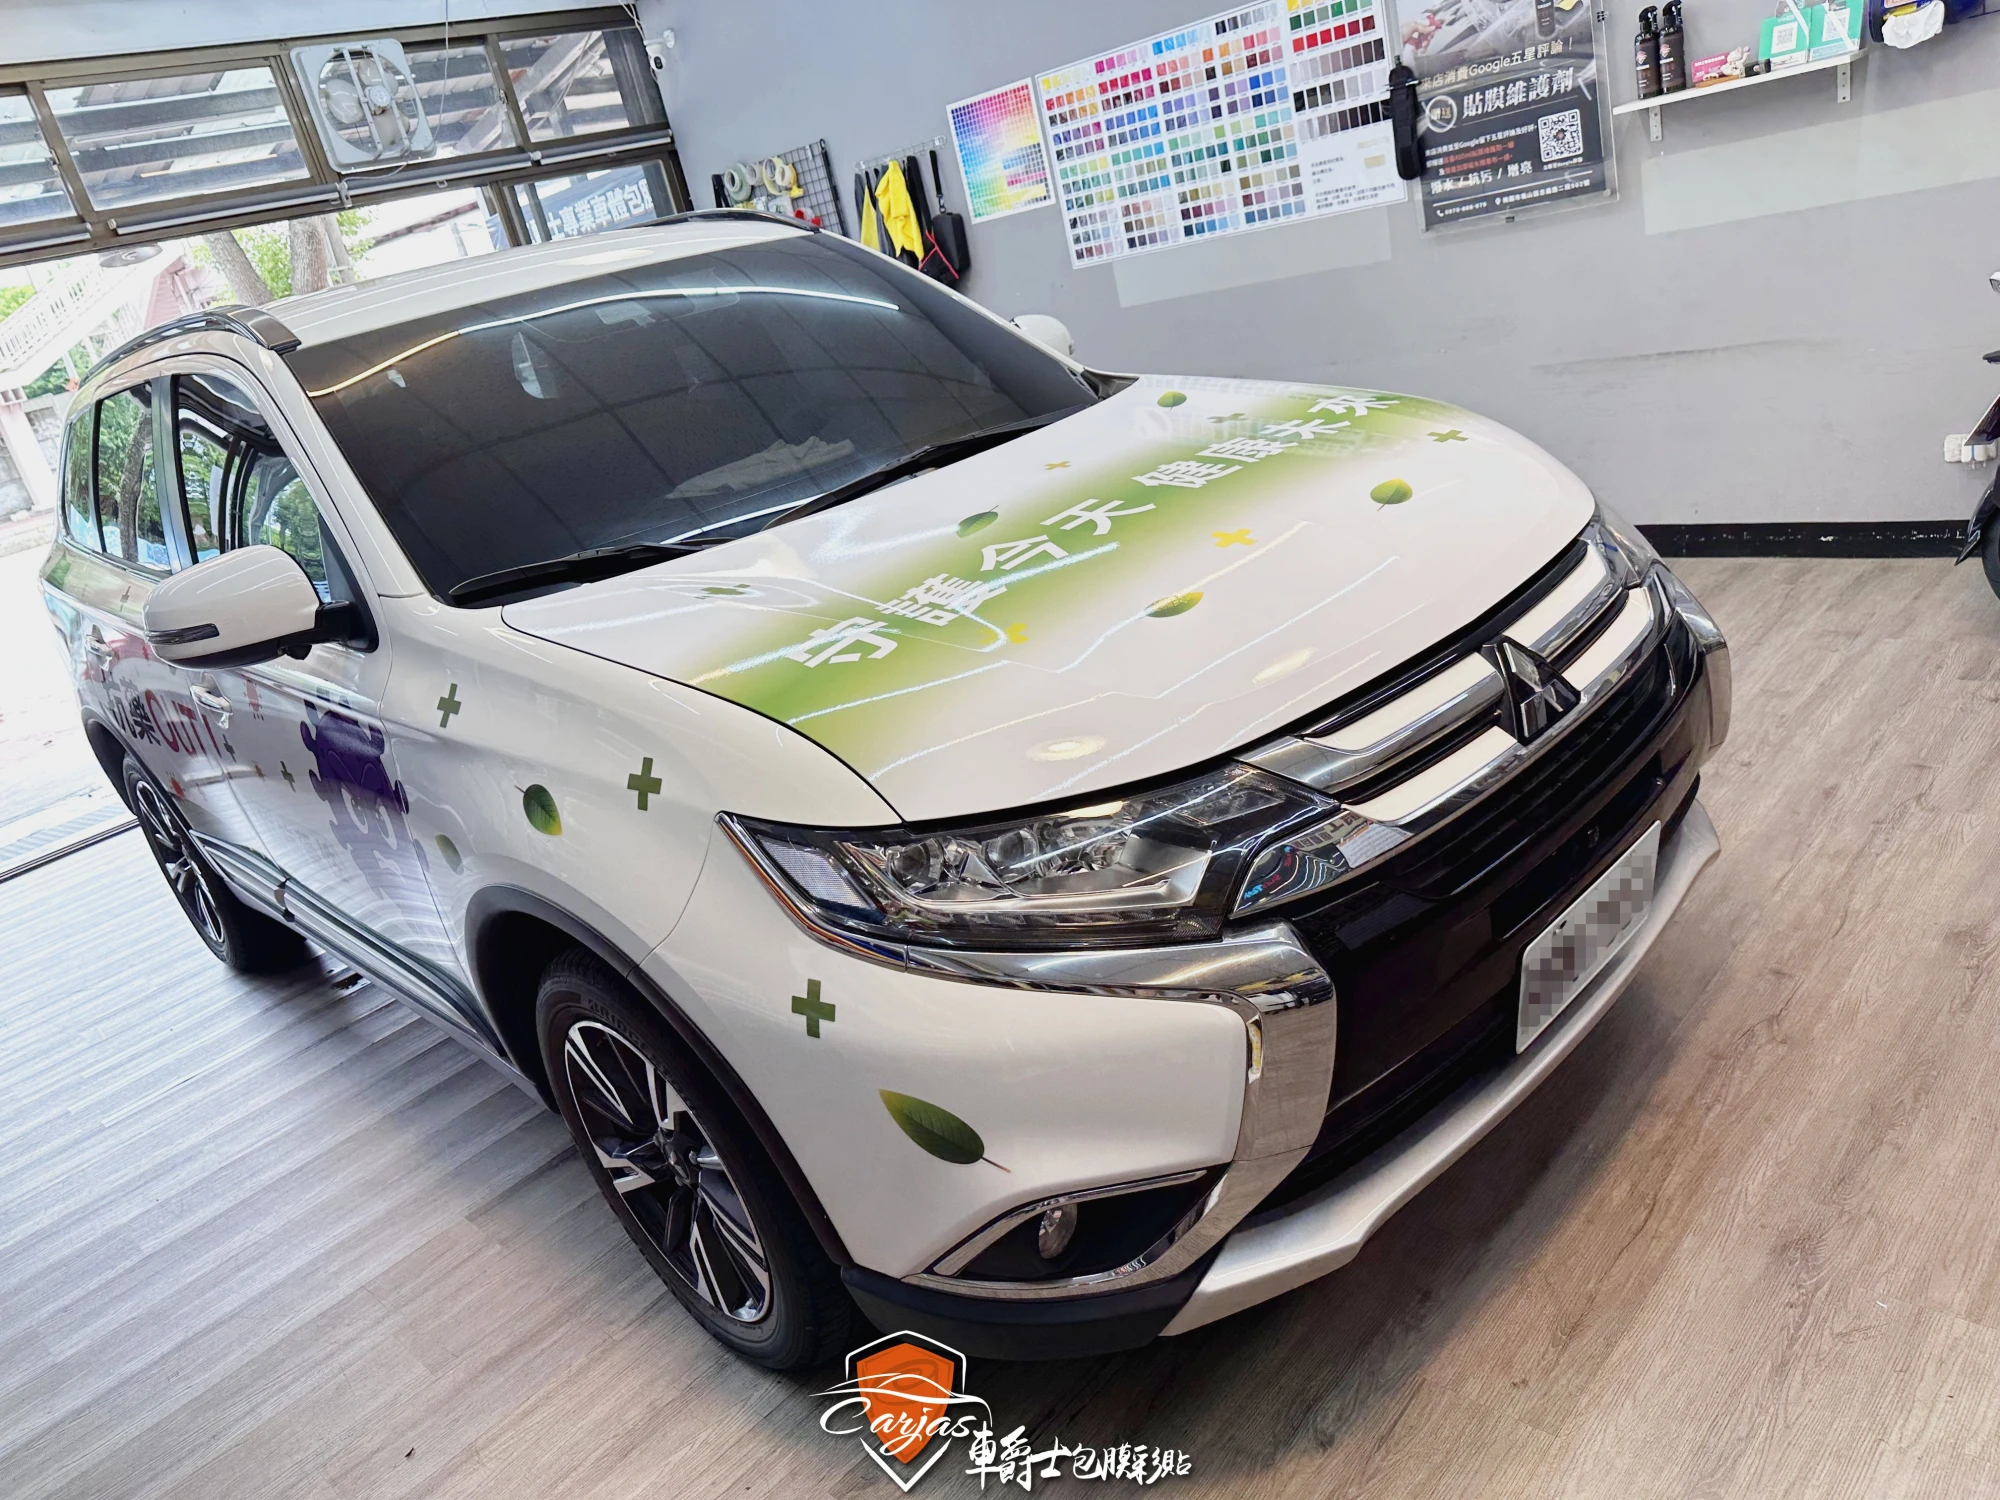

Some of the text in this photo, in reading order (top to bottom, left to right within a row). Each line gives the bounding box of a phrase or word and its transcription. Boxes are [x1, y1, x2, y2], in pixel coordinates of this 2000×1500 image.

[1462, 67, 1574, 119] 貼膜維護劑
[1507, 160, 1533, 178] 增亮
[786, 395, 1400, 668] 守護今天 健康未來
